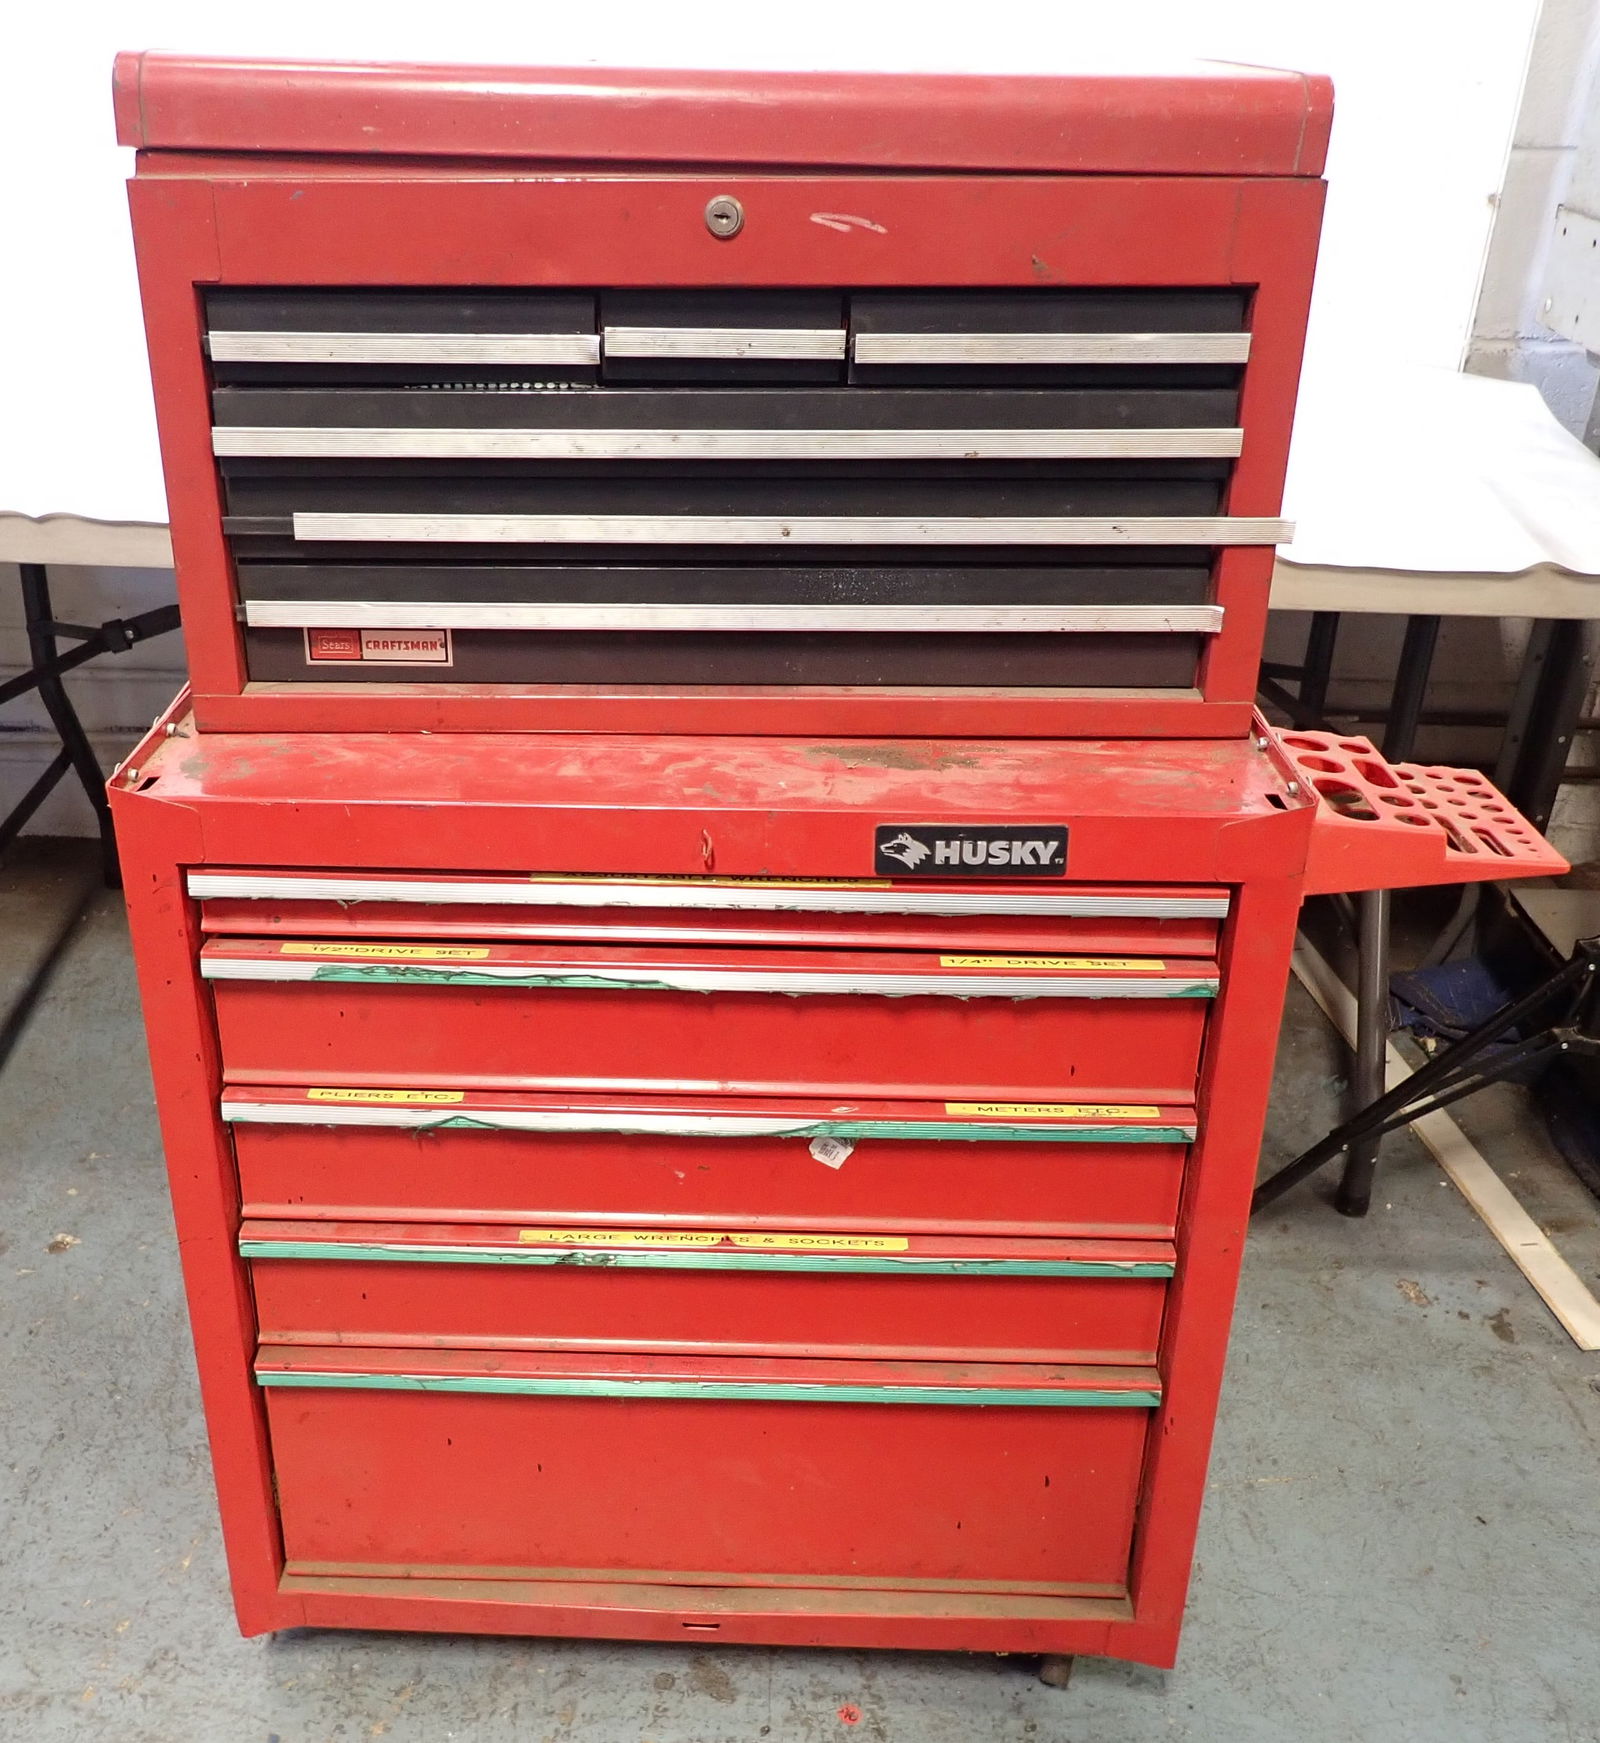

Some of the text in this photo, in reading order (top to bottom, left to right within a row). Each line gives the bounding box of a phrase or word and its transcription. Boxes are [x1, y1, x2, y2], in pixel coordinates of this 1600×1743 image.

[321, 639, 351, 651] Sears
[365, 639, 438, 651] CRAFTSMAN
[935, 840, 1058, 865] HUSKY
[949, 957, 993, 965] 1/4"
[319, 1090, 456, 1100] PLIERS ETC.
[977, 1105, 1128, 1115] METERS ETC.
[549, 1233, 618, 1241] LARGE
[634, 1234, 750, 1243] WRENCHS
[788, 1237, 885, 1247] SOCKETS
